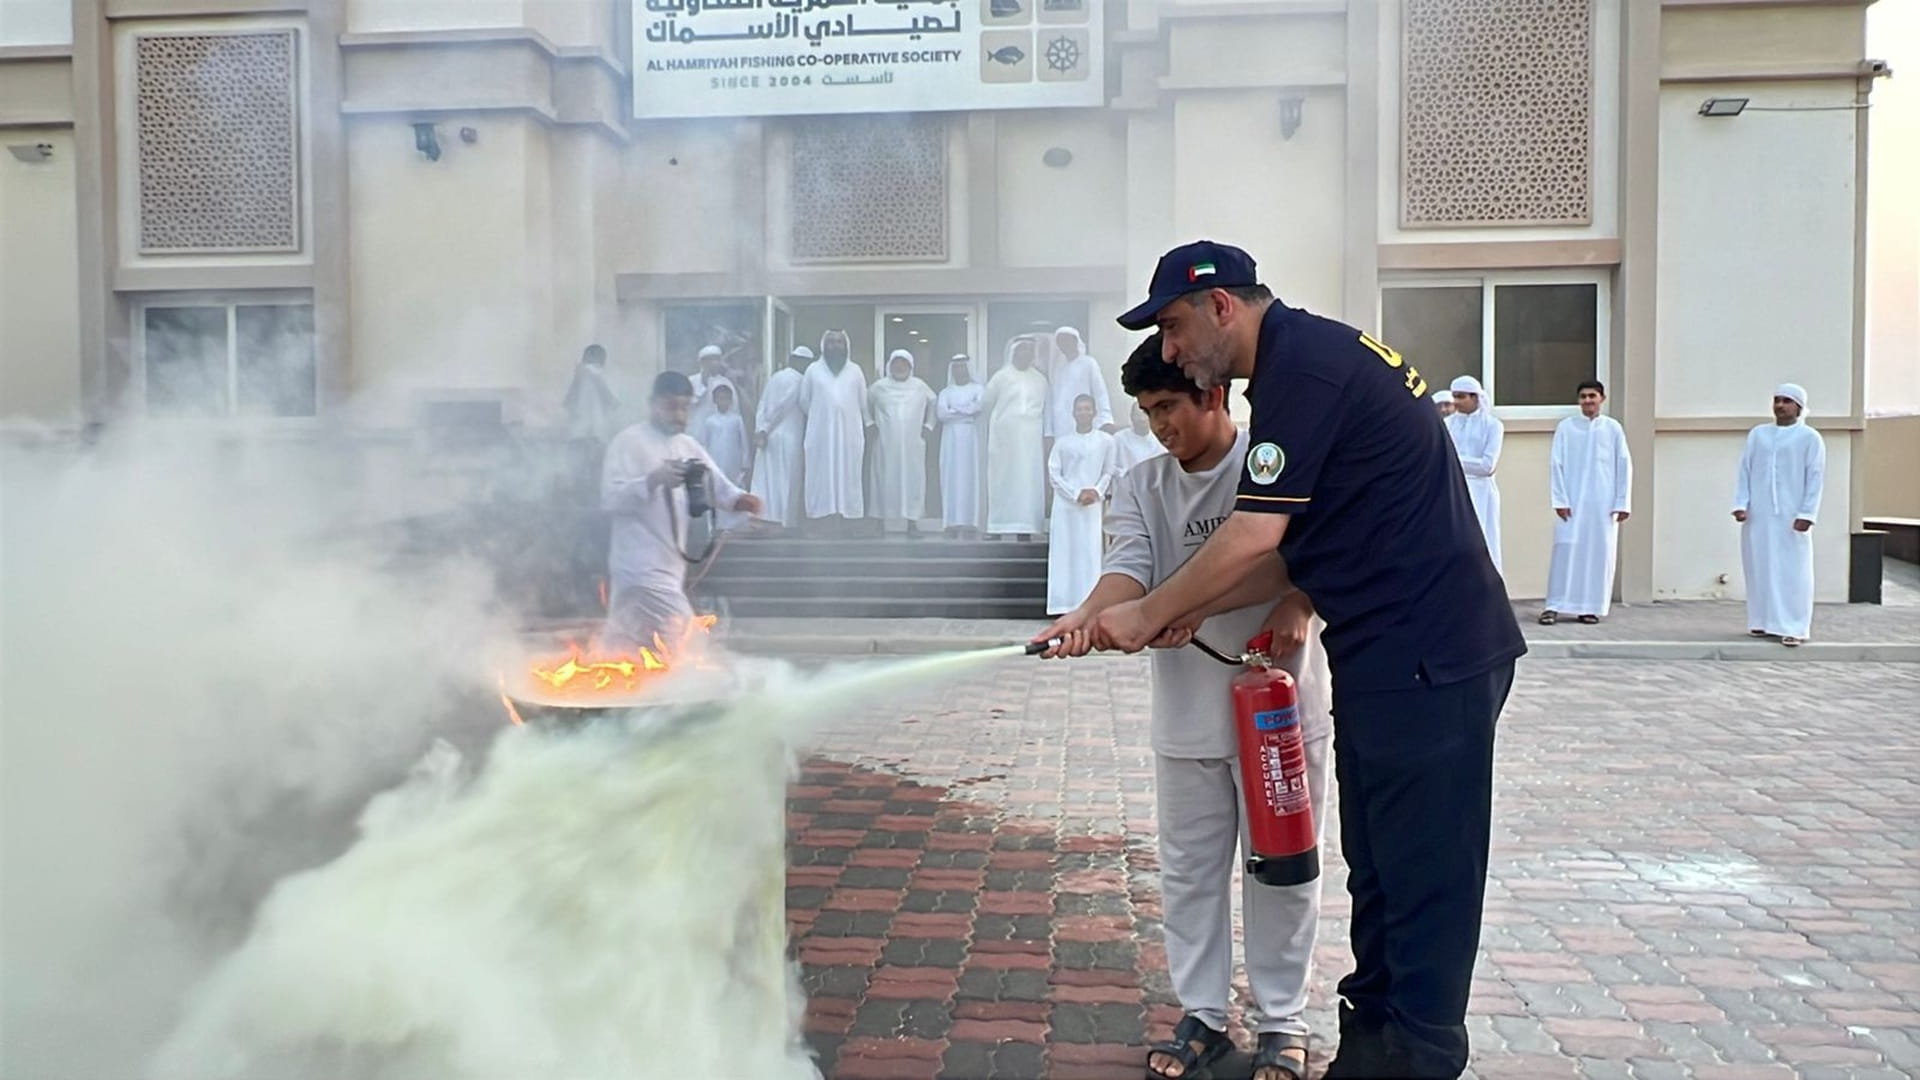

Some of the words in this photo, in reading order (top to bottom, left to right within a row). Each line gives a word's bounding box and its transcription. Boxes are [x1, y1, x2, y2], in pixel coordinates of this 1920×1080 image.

[646, 12, 799, 43] الأسماك
[804, 10, 961, 47] لصيادي
[647, 60, 665, 71] AL
[666, 57, 738, 70] HAMRIYAH
[740, 55, 795, 68] FISHING
[796, 51, 899, 66] CO-OPERATIVE
[901, 50, 962, 63] SOCIETY
[710, 76, 760, 89] SINCE
[768, 75, 812, 87] 2004
